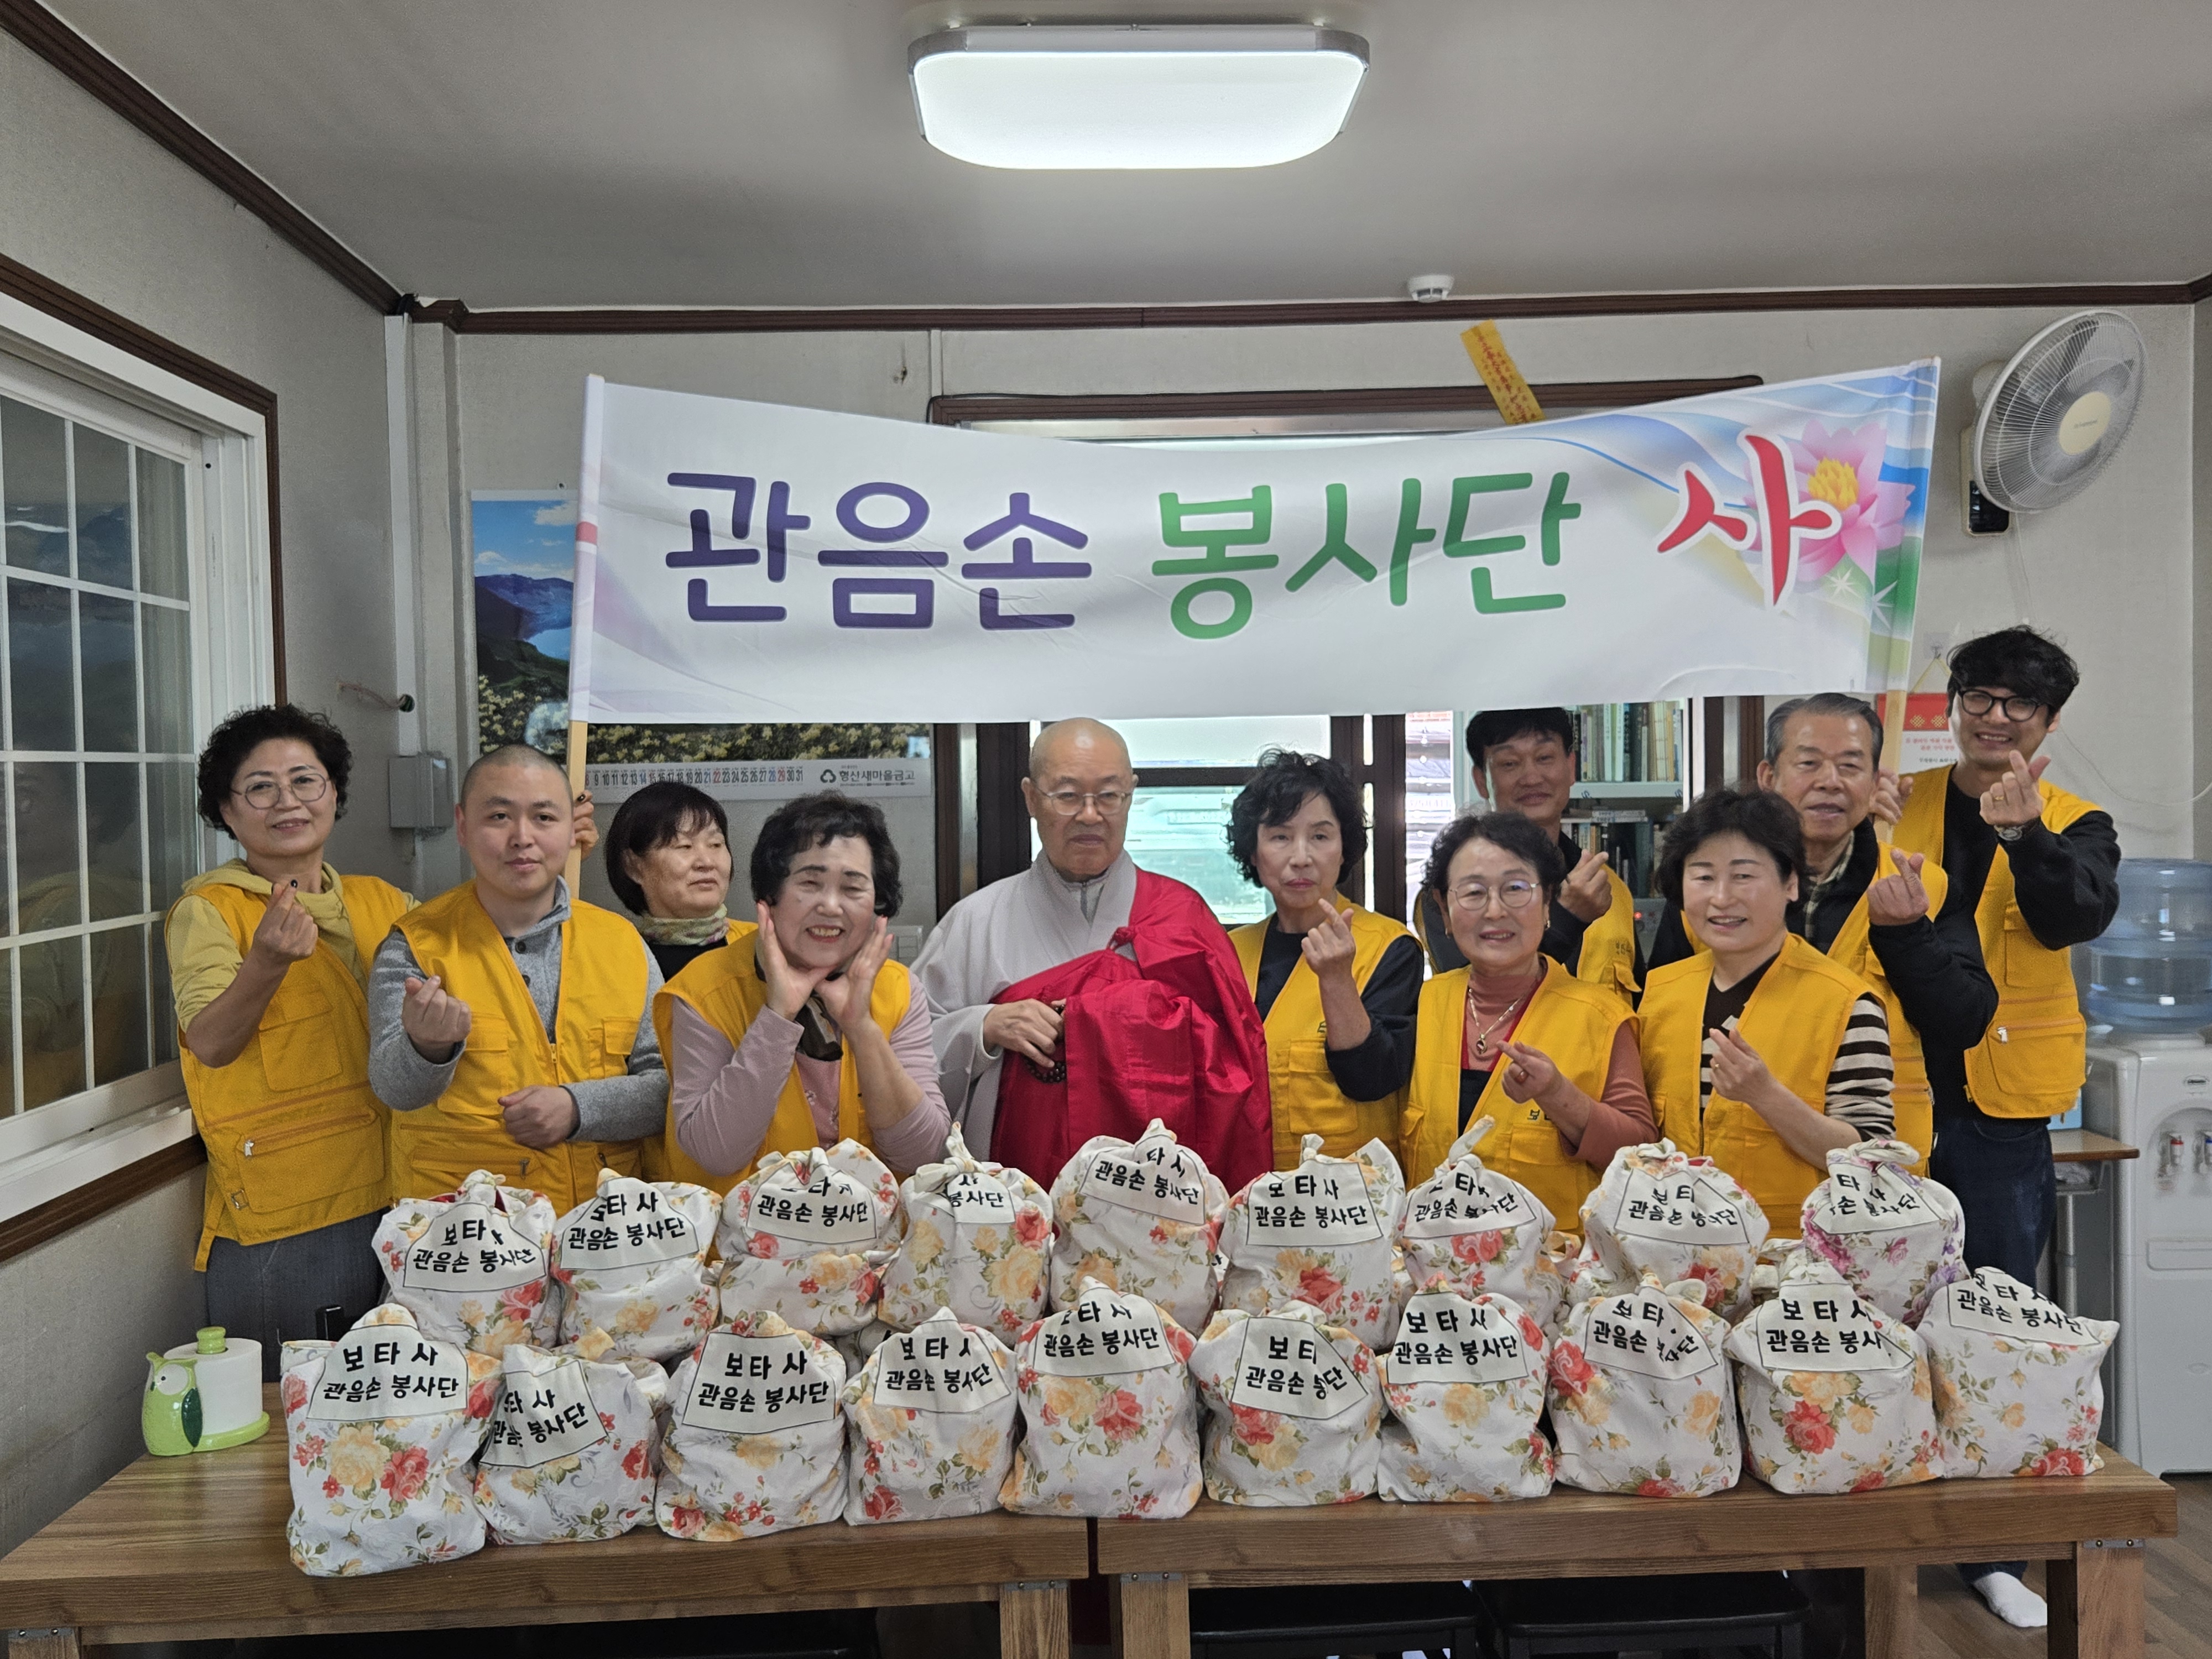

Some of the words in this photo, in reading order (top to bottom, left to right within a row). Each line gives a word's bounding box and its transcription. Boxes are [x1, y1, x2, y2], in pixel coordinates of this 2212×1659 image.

[665, 472, 1093, 630] 관음손
[1151, 471, 1582, 640] 봉사단
[1657, 434, 1833, 607] 사
[594, 774, 599, 786] 9
[602, 774, 610, 786] 10
[611, 774, 618, 785] 11
[620, 773, 628, 785] 12
[630, 773, 638, 785] 13
[639, 773, 647, 784] 14
[667, 772, 675, 783] 17
[676, 772, 684, 783] 18
[686, 772, 693, 784] 19
[695, 771, 703, 784] 20
[704, 771, 711, 783] 21
[713, 771, 721, 783] 22
[722, 771, 730, 783] 23
[732, 771, 739, 782] 24
[741, 770, 749, 782] 25
[750, 770, 758, 782] 26
[759, 770, 767, 782] 27
[769, 770, 776, 782] 28
[778, 770, 785, 782] 29
[787, 769, 794, 781] 30
[796, 769, 804, 781] 31
[1095, 1161, 1145, 1191] 관음손
[758, 1194, 812, 1223] 관음손
[821, 1201, 868, 1227] 봉사단
[1254, 1206, 1306, 1227] 관음손
[1315, 1205, 1368, 1229] 봉사단
[1415, 1198, 1458, 1222] 관음손
[568, 1227, 619, 1251] 관음손
[626, 1217, 686, 1246] 봉사단
[413, 1249, 470, 1274] 관음손
[479, 1249, 536, 1273] 봉사단
[1957, 1289, 2013, 1324] 관음손
[1044, 1333, 1094, 1358] 관음손
[1102, 1327, 1160, 1355] 봉사단
[1394, 1341, 1453, 1365] 관음손
[1460, 1335, 1517, 1365] 봉사단
[1593, 1320, 1647, 1354] 관음손
[1766, 1329, 1830, 1353] 관음손
[323, 1376, 382, 1402] 관음손
[392, 1375, 459, 1399] 봉사단
[885, 1369, 936, 1391] 관음손
[943, 1363, 993, 1394] 봉사단
[1245, 1366, 1305, 1395] 관음손
[698, 1383, 756, 1413] 관음손
[765, 1381, 829, 1413] 봉사단
[527, 1402, 589, 1443] 봉사단
